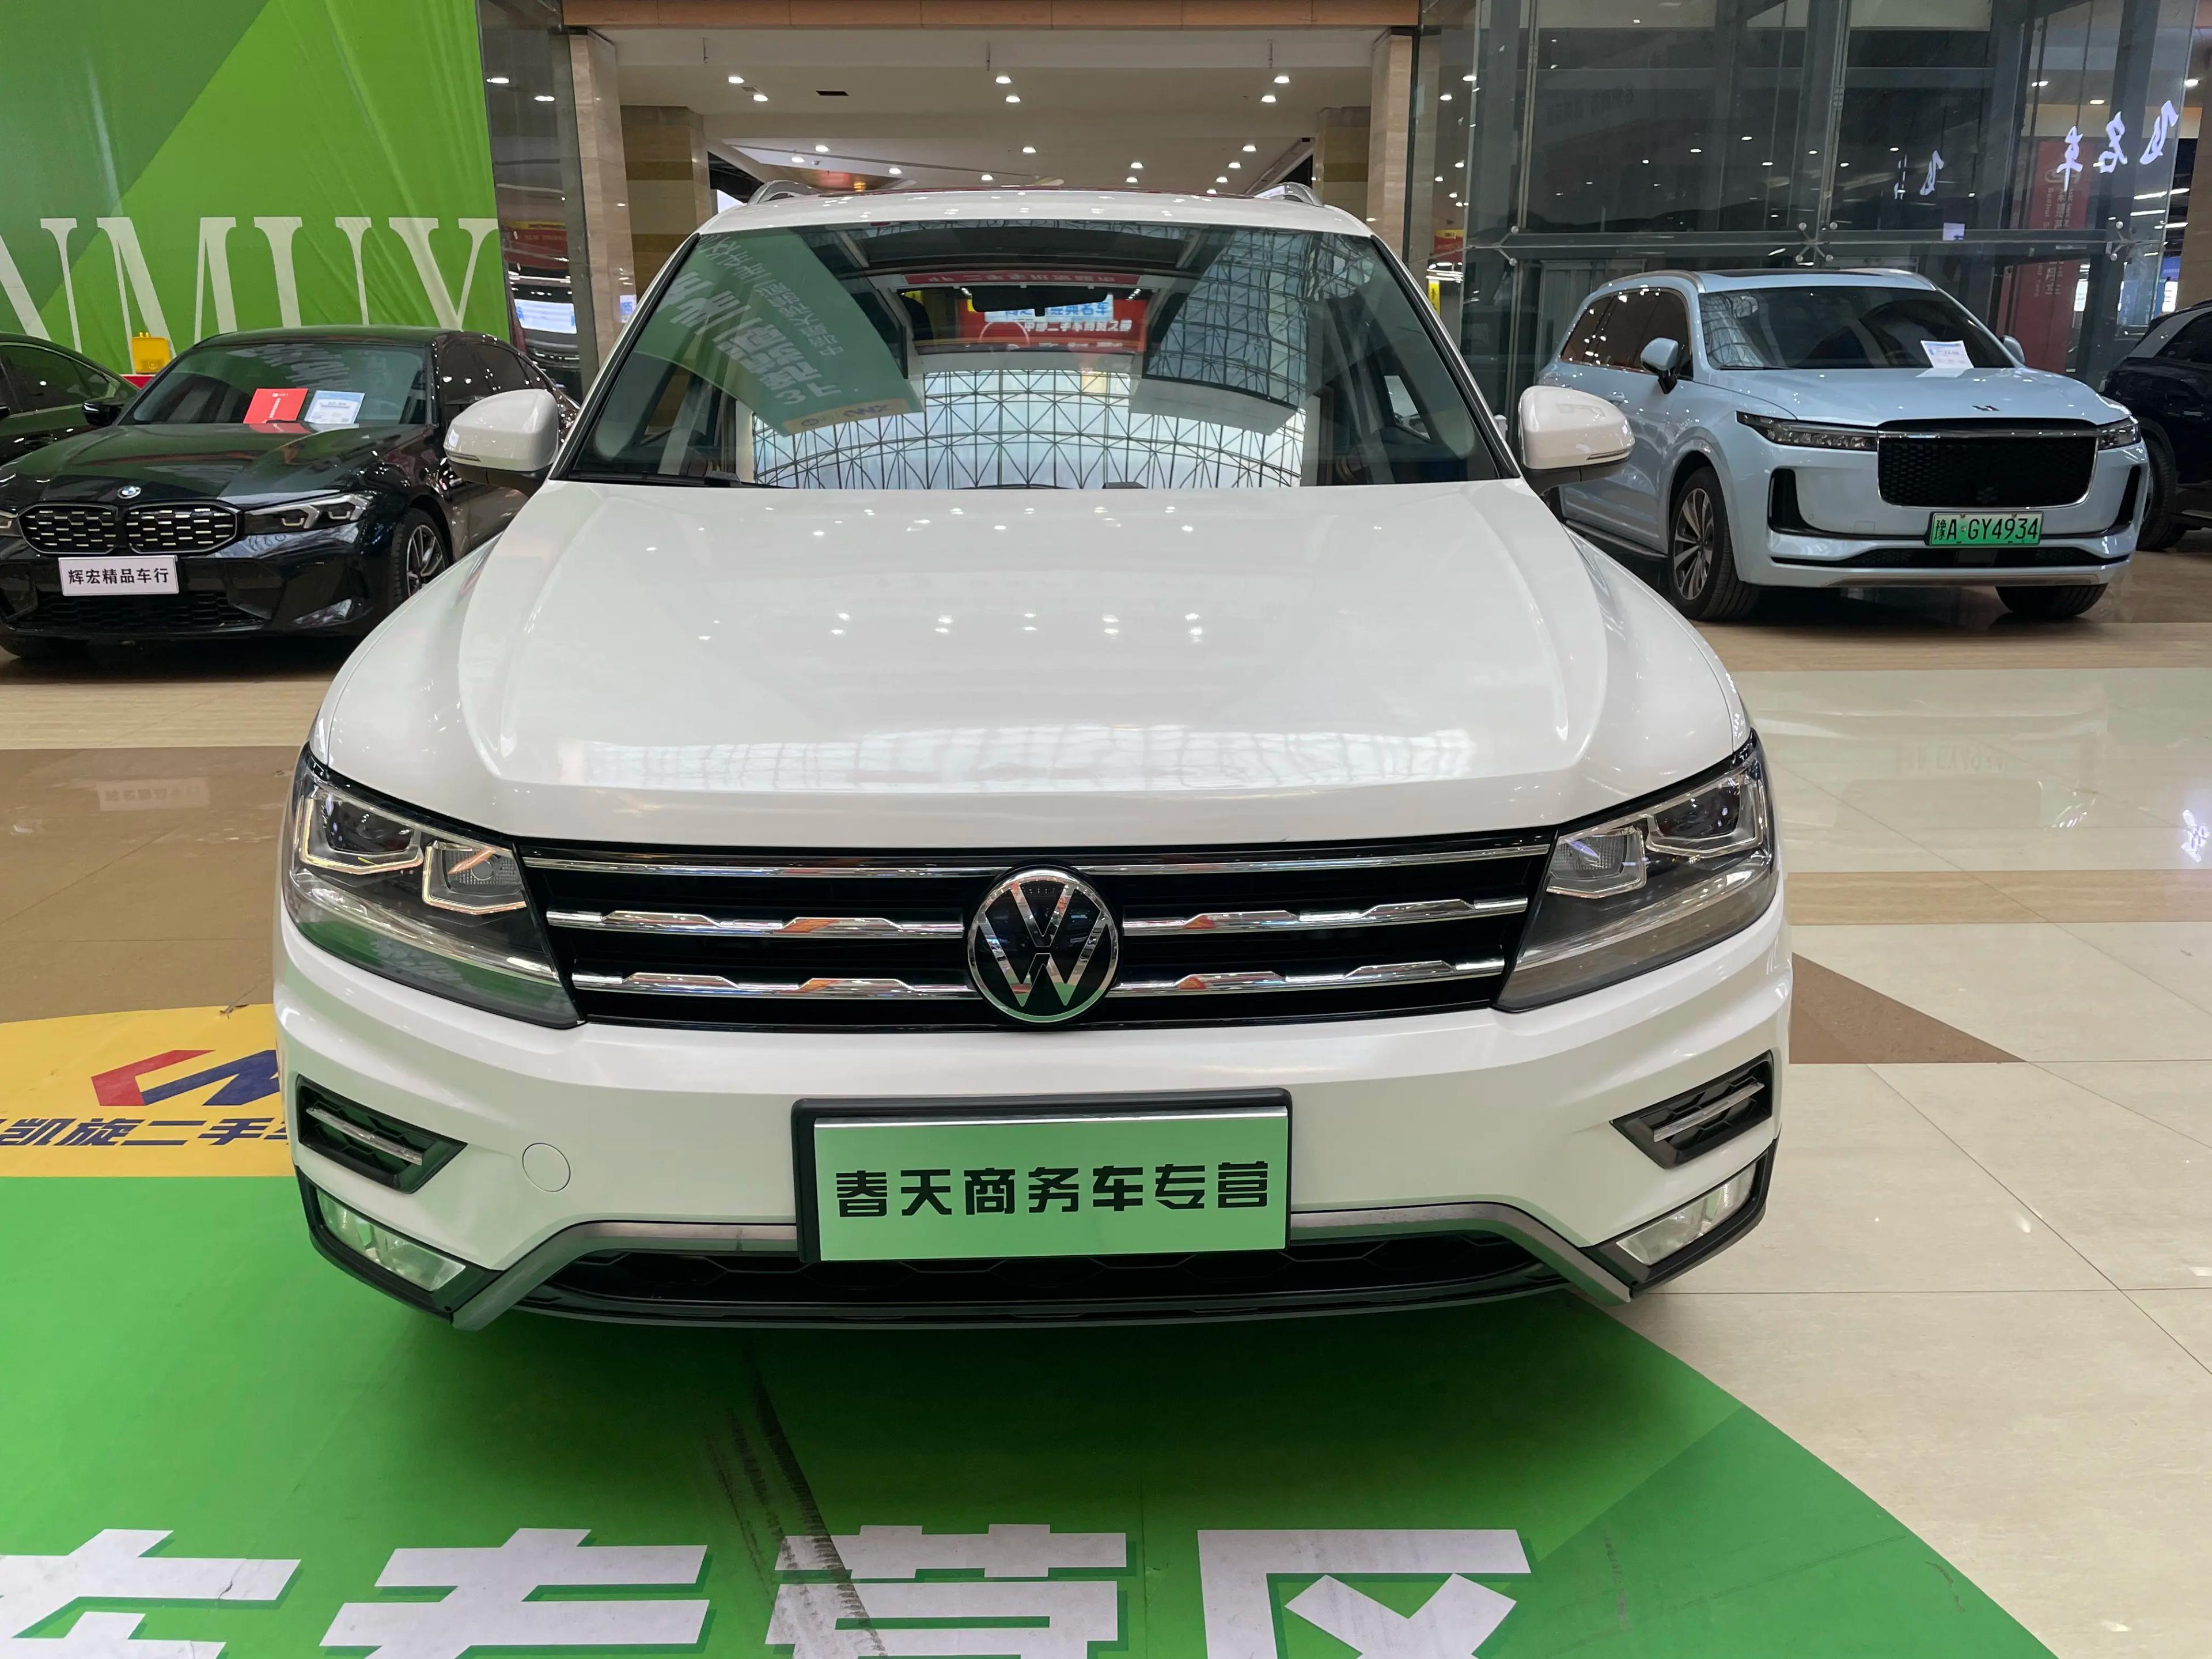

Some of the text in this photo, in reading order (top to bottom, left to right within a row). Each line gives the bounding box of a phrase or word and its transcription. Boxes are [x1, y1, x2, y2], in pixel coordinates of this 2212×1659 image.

[68, 567, 169, 585] 辉宏精品车行
[0, 1118, 289, 1146] 凯旋二手
[835, 1160, 1270, 1218] 春天商务车专营
